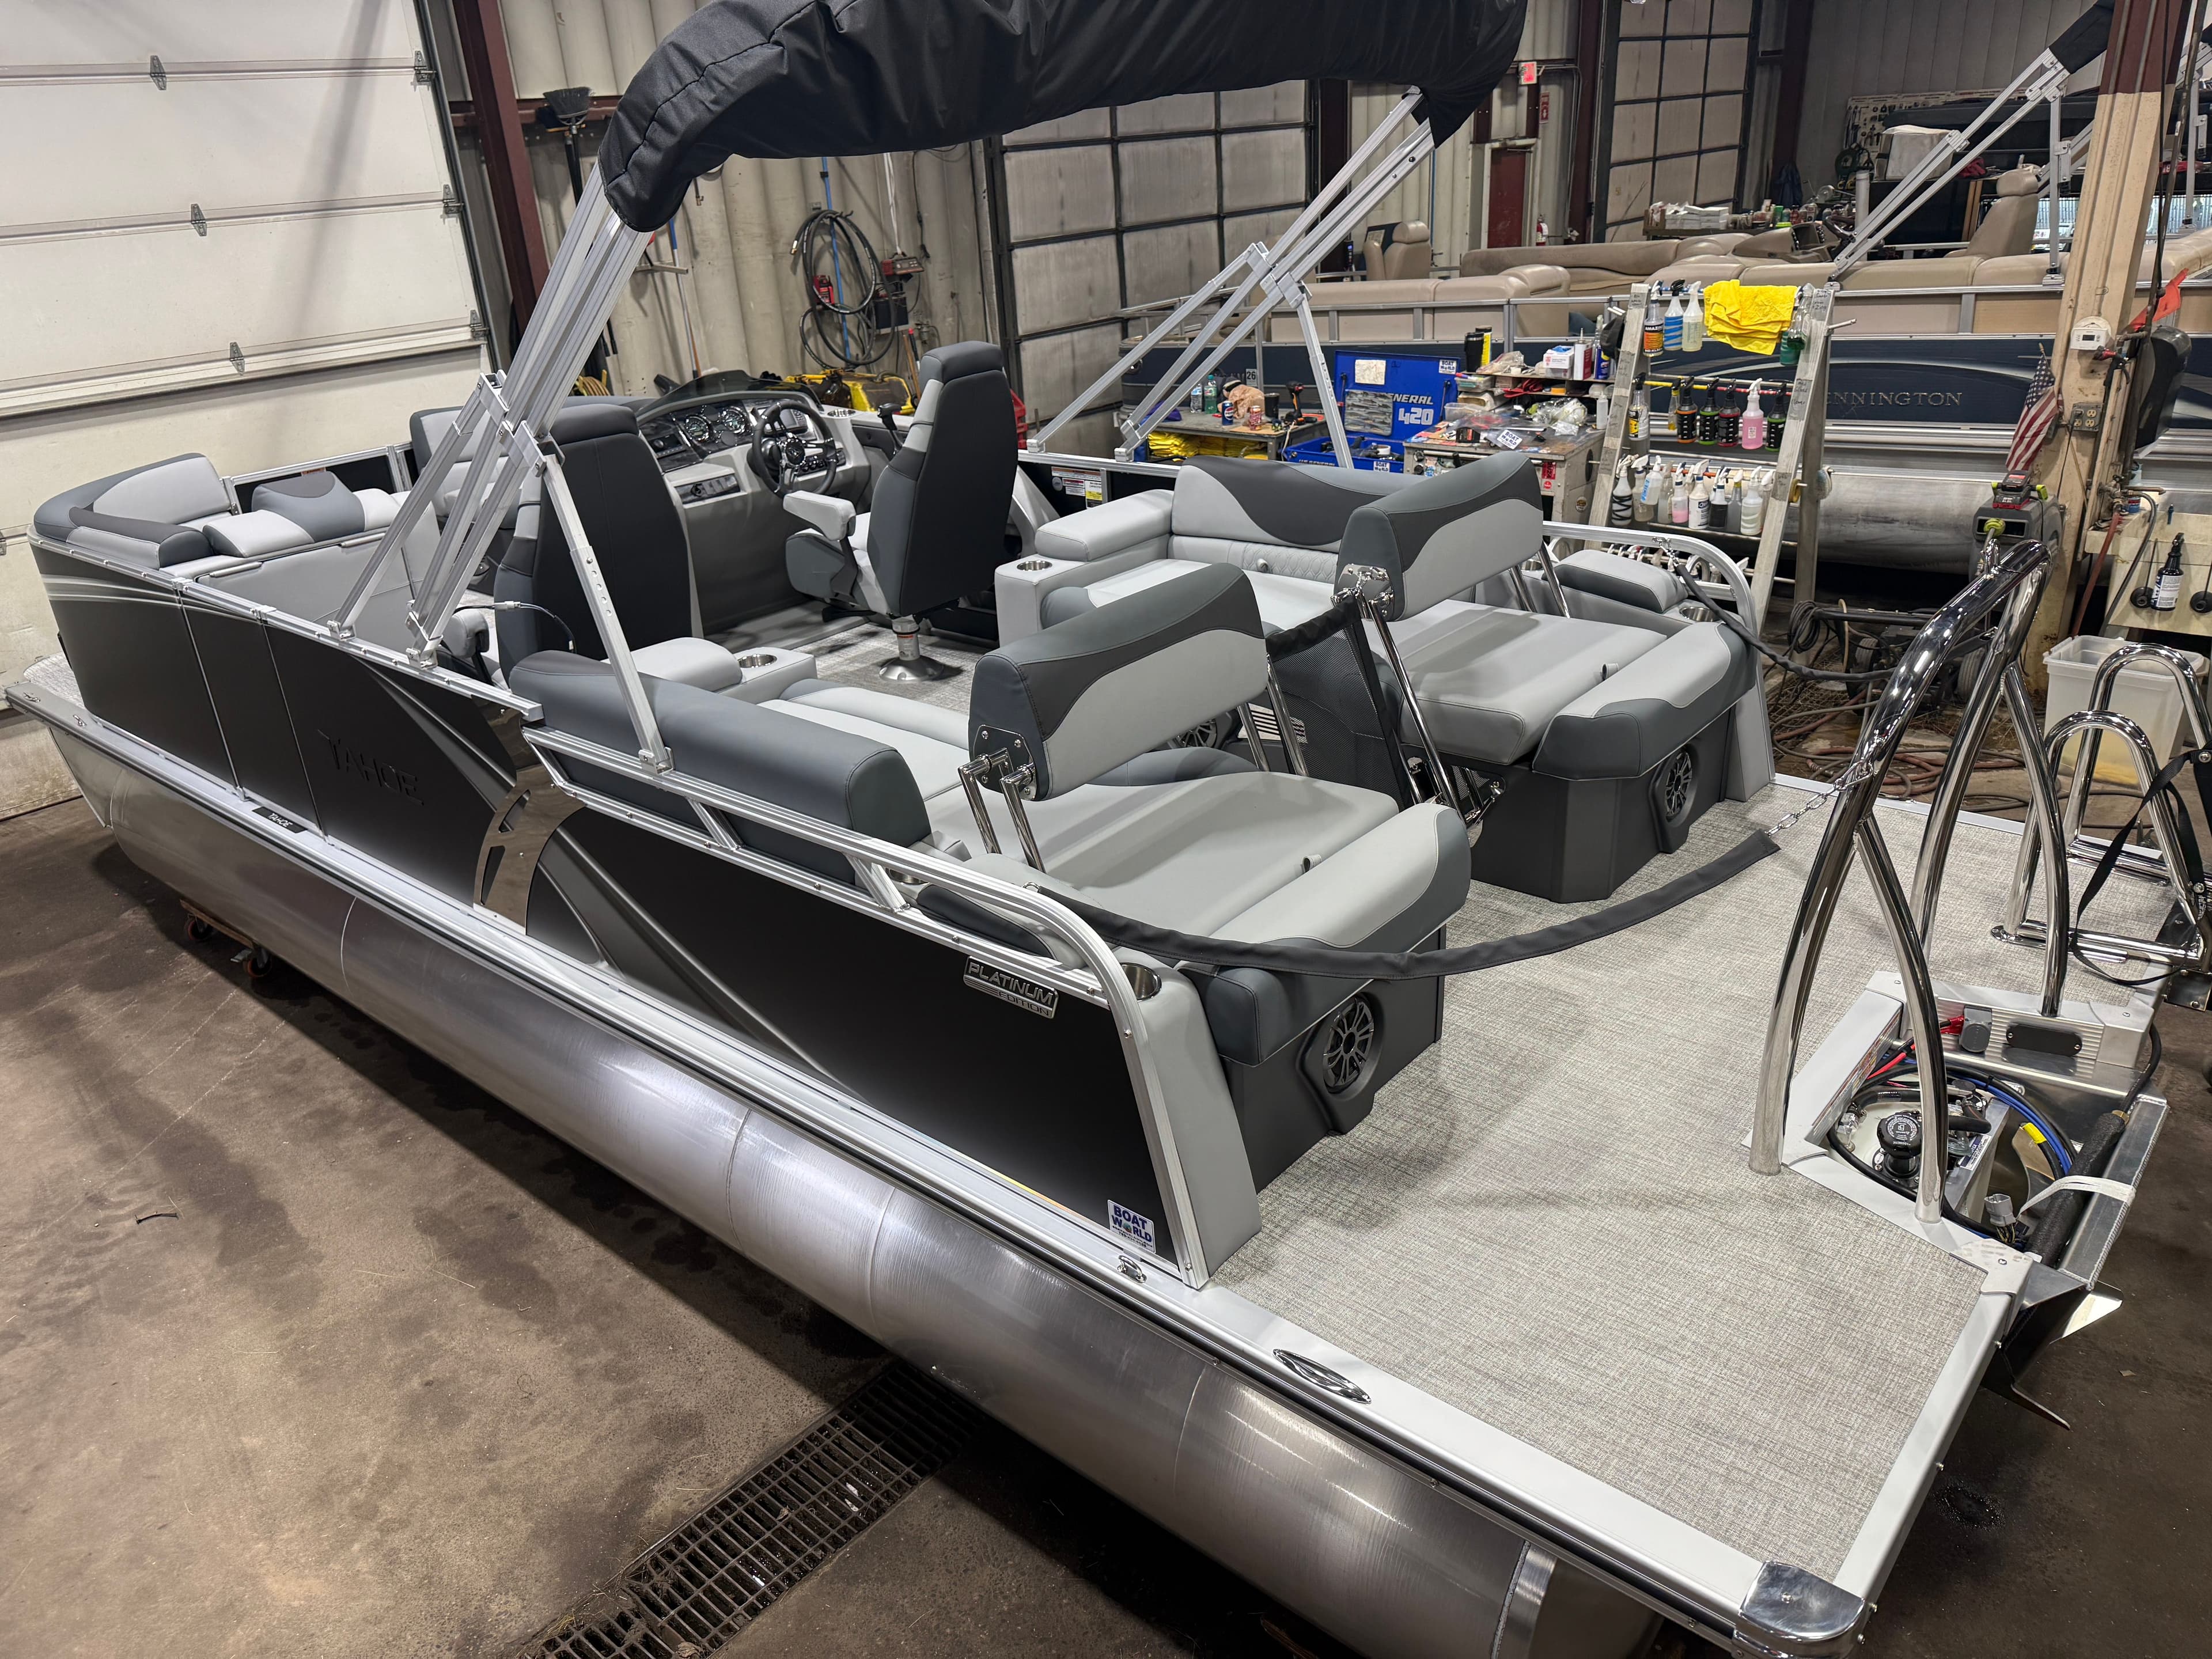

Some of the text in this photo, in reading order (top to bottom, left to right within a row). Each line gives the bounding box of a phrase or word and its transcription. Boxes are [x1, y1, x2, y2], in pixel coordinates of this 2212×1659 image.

[1247, 371, 1256, 380] 26
[1827, 392, 1963, 406] NNINGTON
[1398, 408, 1434, 425] 420
[1505, 431, 1519, 441] BOAT
[317, 729, 425, 806] TAHOE
[268, 813, 293, 828] TAHOE
[968, 962, 1054, 1005] PLATINUM
[998, 991, 1049, 1016] EDITION
[1113, 1205, 1147, 1230] BOAT
